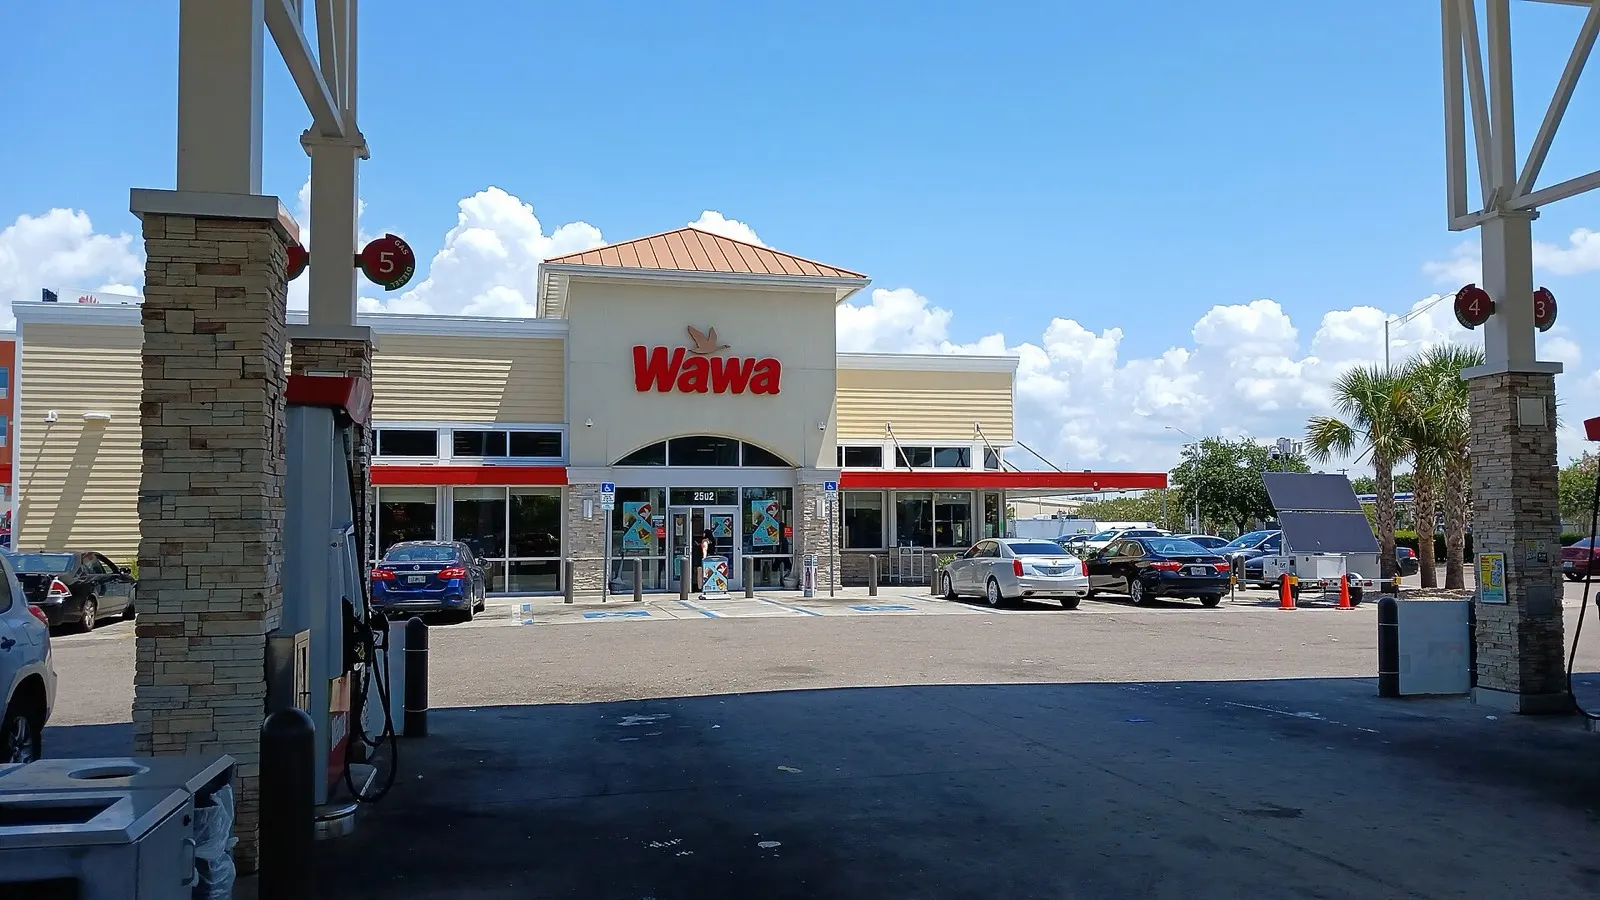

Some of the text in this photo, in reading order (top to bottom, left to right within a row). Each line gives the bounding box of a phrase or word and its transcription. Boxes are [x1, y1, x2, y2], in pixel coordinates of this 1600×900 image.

[395, 240, 409, 255] GAS
[380, 252, 394, 273] 5
[390, 266, 412, 288] DIESEL
[1458, 288, 1468, 300] GAS
[1468, 298, 1480, 316] 4
[1536, 301, 1545, 318] 3
[633, 345, 782, 395] Wawa
[693, 491, 715, 501] 2502
